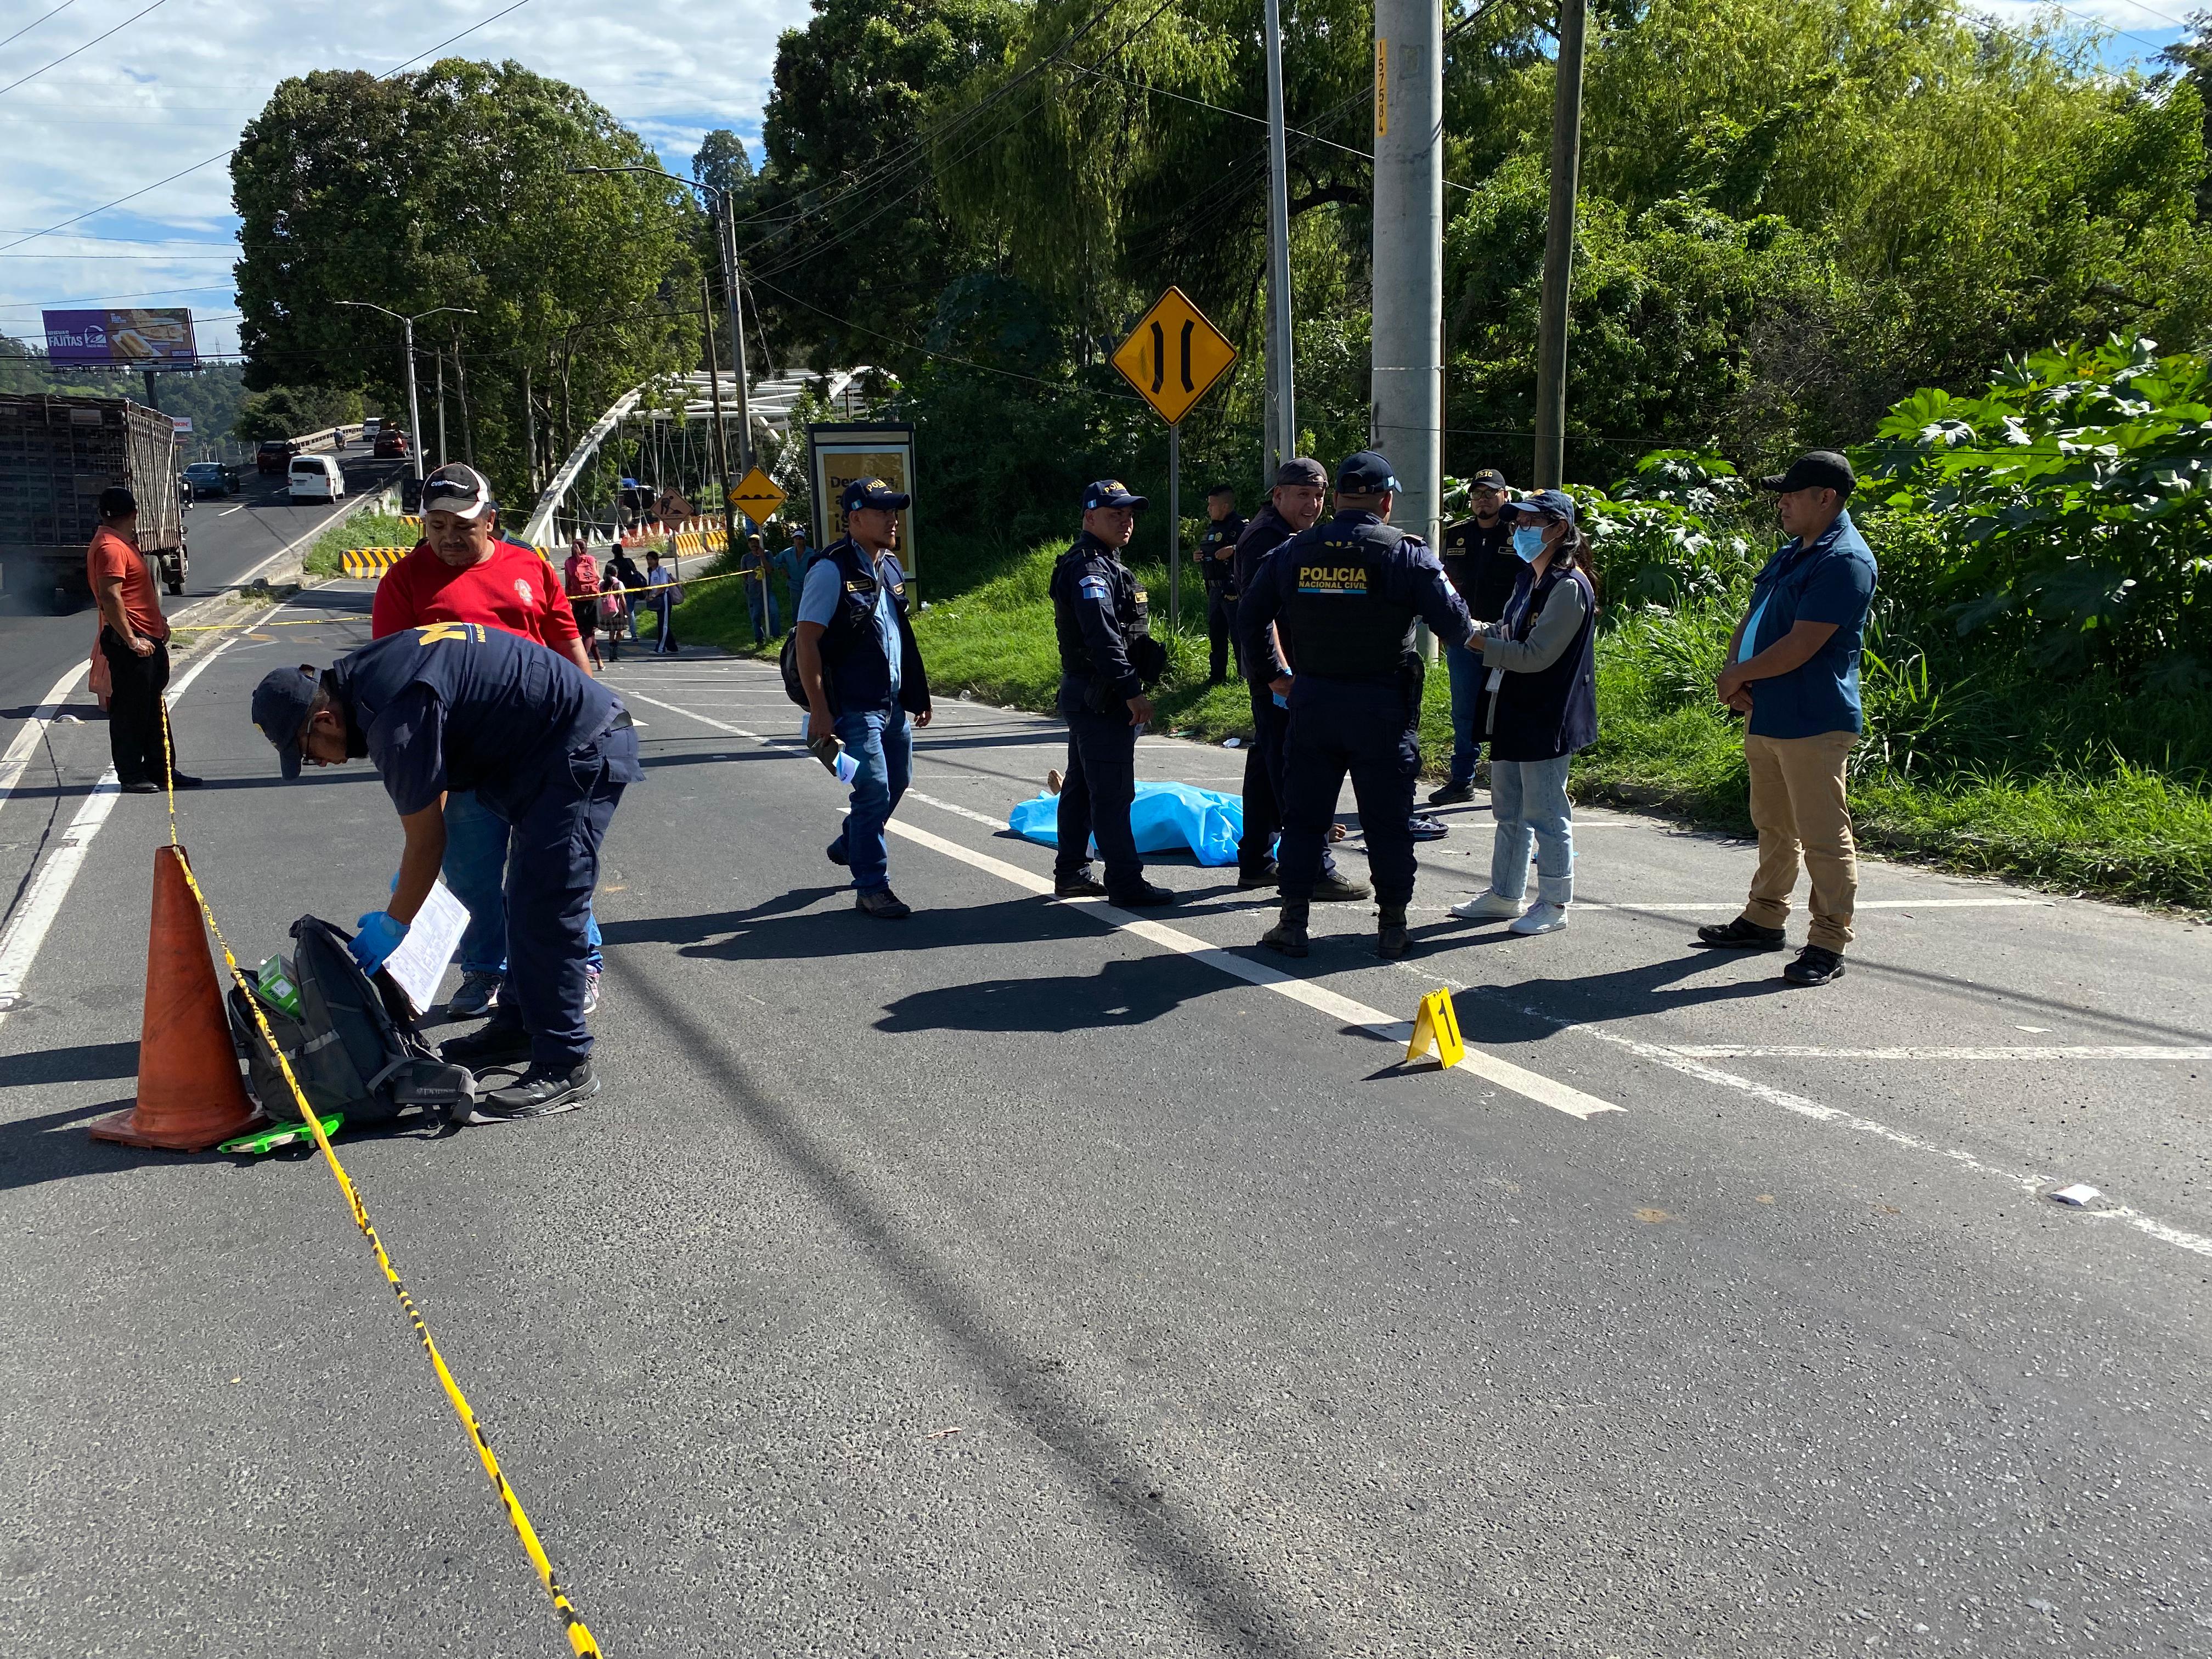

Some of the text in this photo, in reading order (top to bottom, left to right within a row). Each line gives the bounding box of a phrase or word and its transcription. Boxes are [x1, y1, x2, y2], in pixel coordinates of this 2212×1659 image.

[48, 335, 83, 347] FAJITAS
[1299, 567, 1367, 582] POLICIA
[1299, 581, 1367, 590] NACIONAL CIVIL
[1438, 998, 1455, 1047] 1
